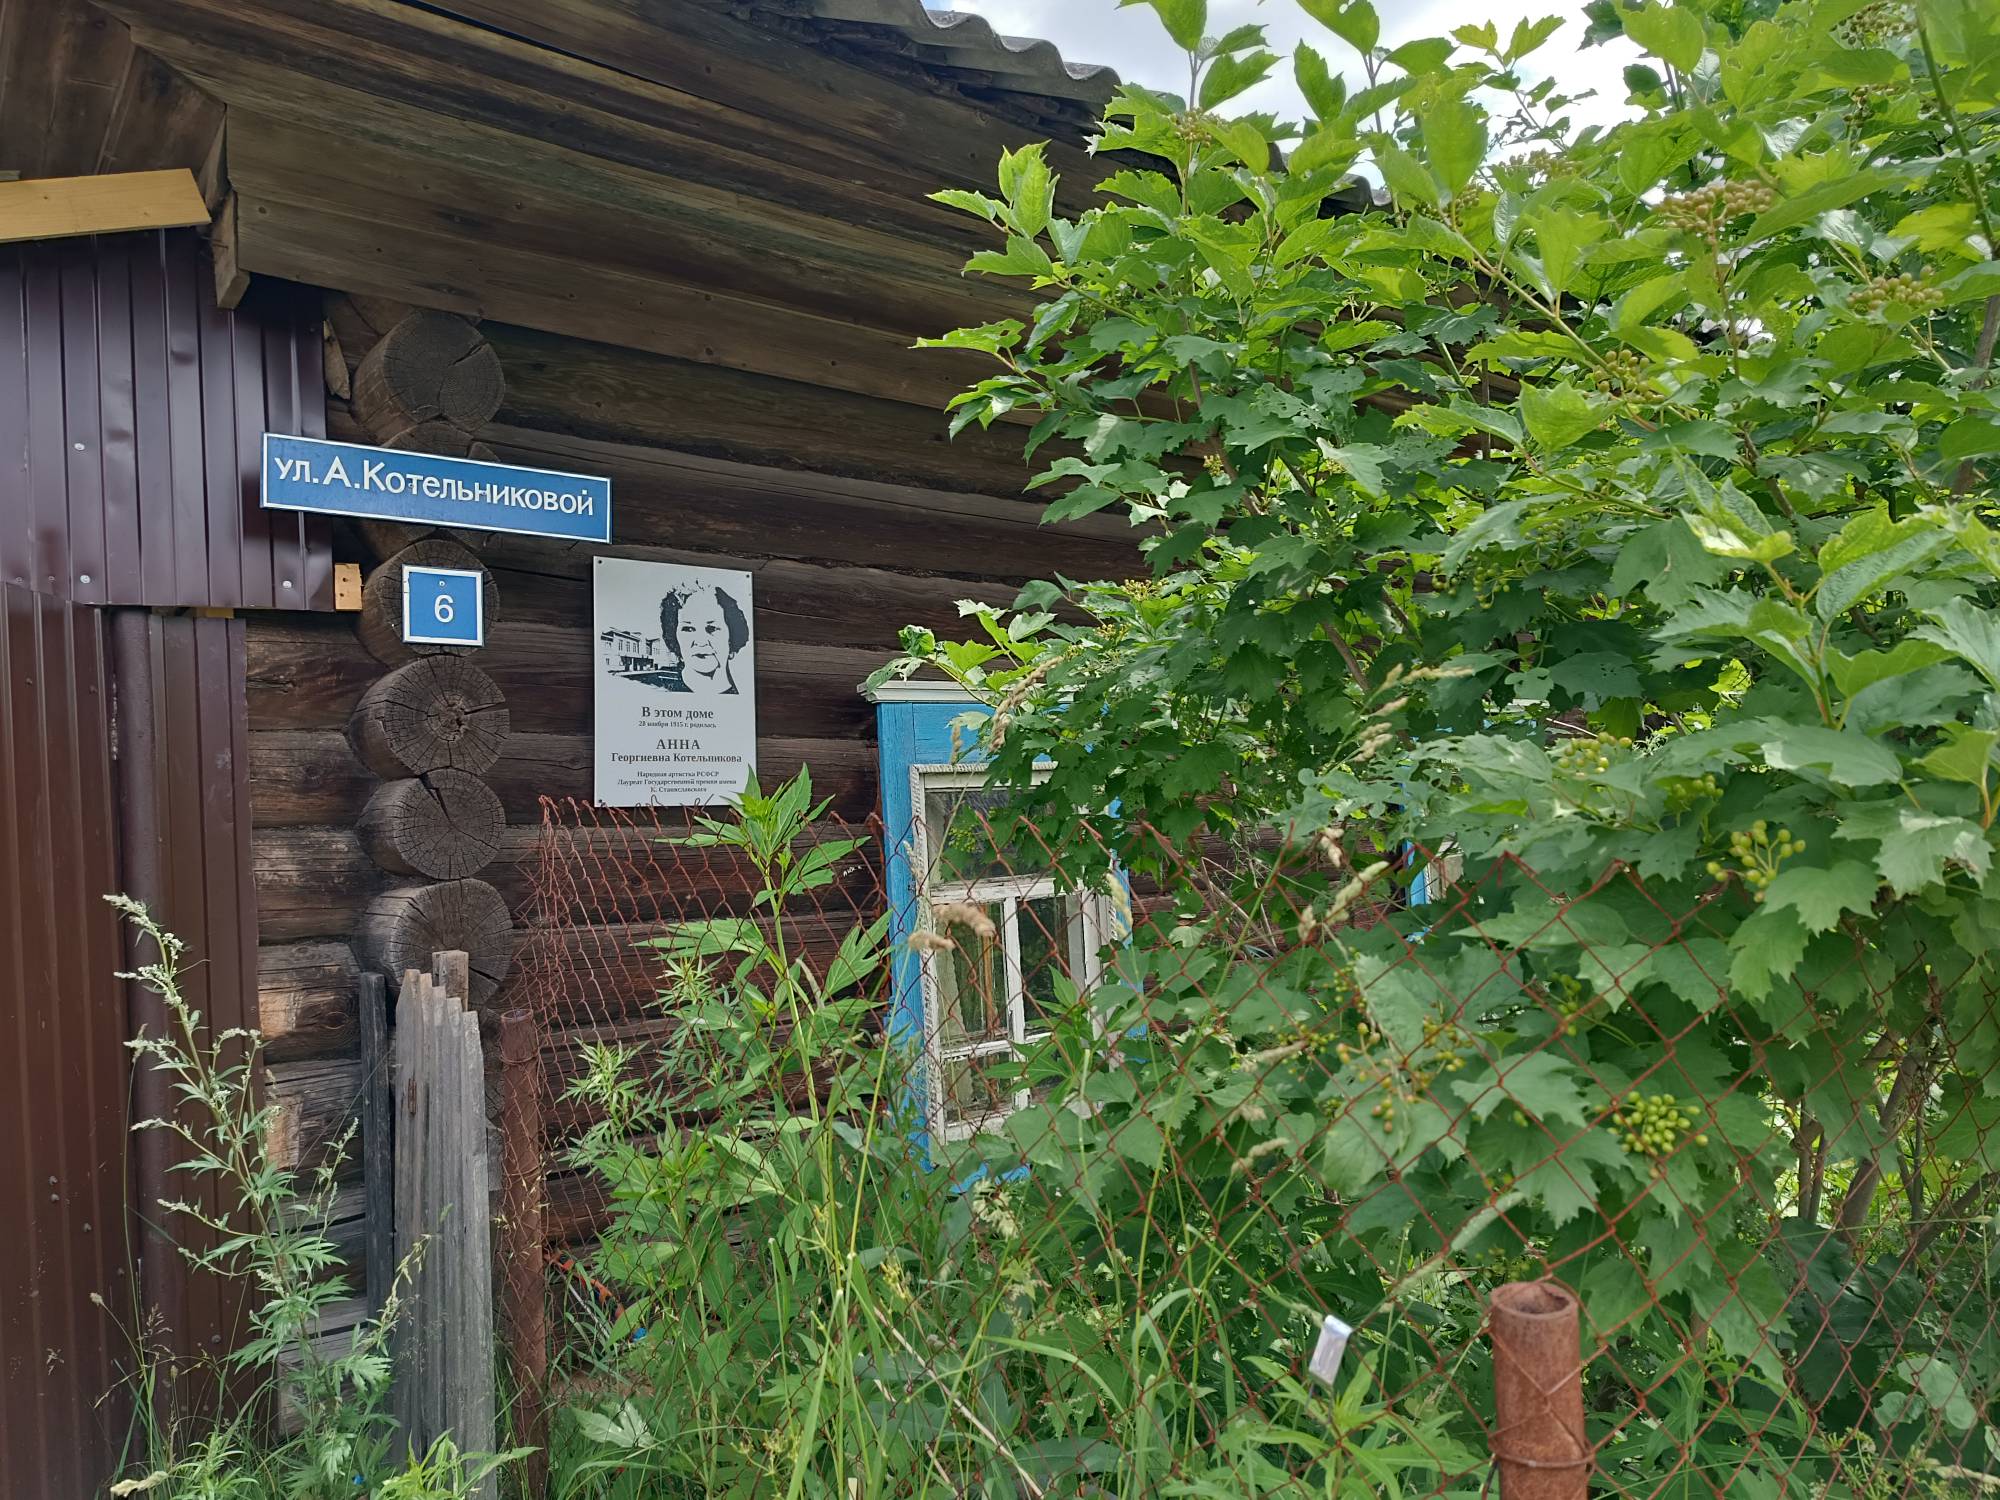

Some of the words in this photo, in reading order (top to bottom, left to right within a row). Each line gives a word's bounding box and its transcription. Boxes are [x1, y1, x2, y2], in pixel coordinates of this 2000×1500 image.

[434, 594, 454, 623] 6
[642, 706, 651, 718] В
[654, 709, 682, 718] этом
[685, 710, 714, 721] доме
[656, 739, 701, 750] АННА
[611, 753, 671, 765] Георгиевна
[673, 753, 742, 763] Котельникова
